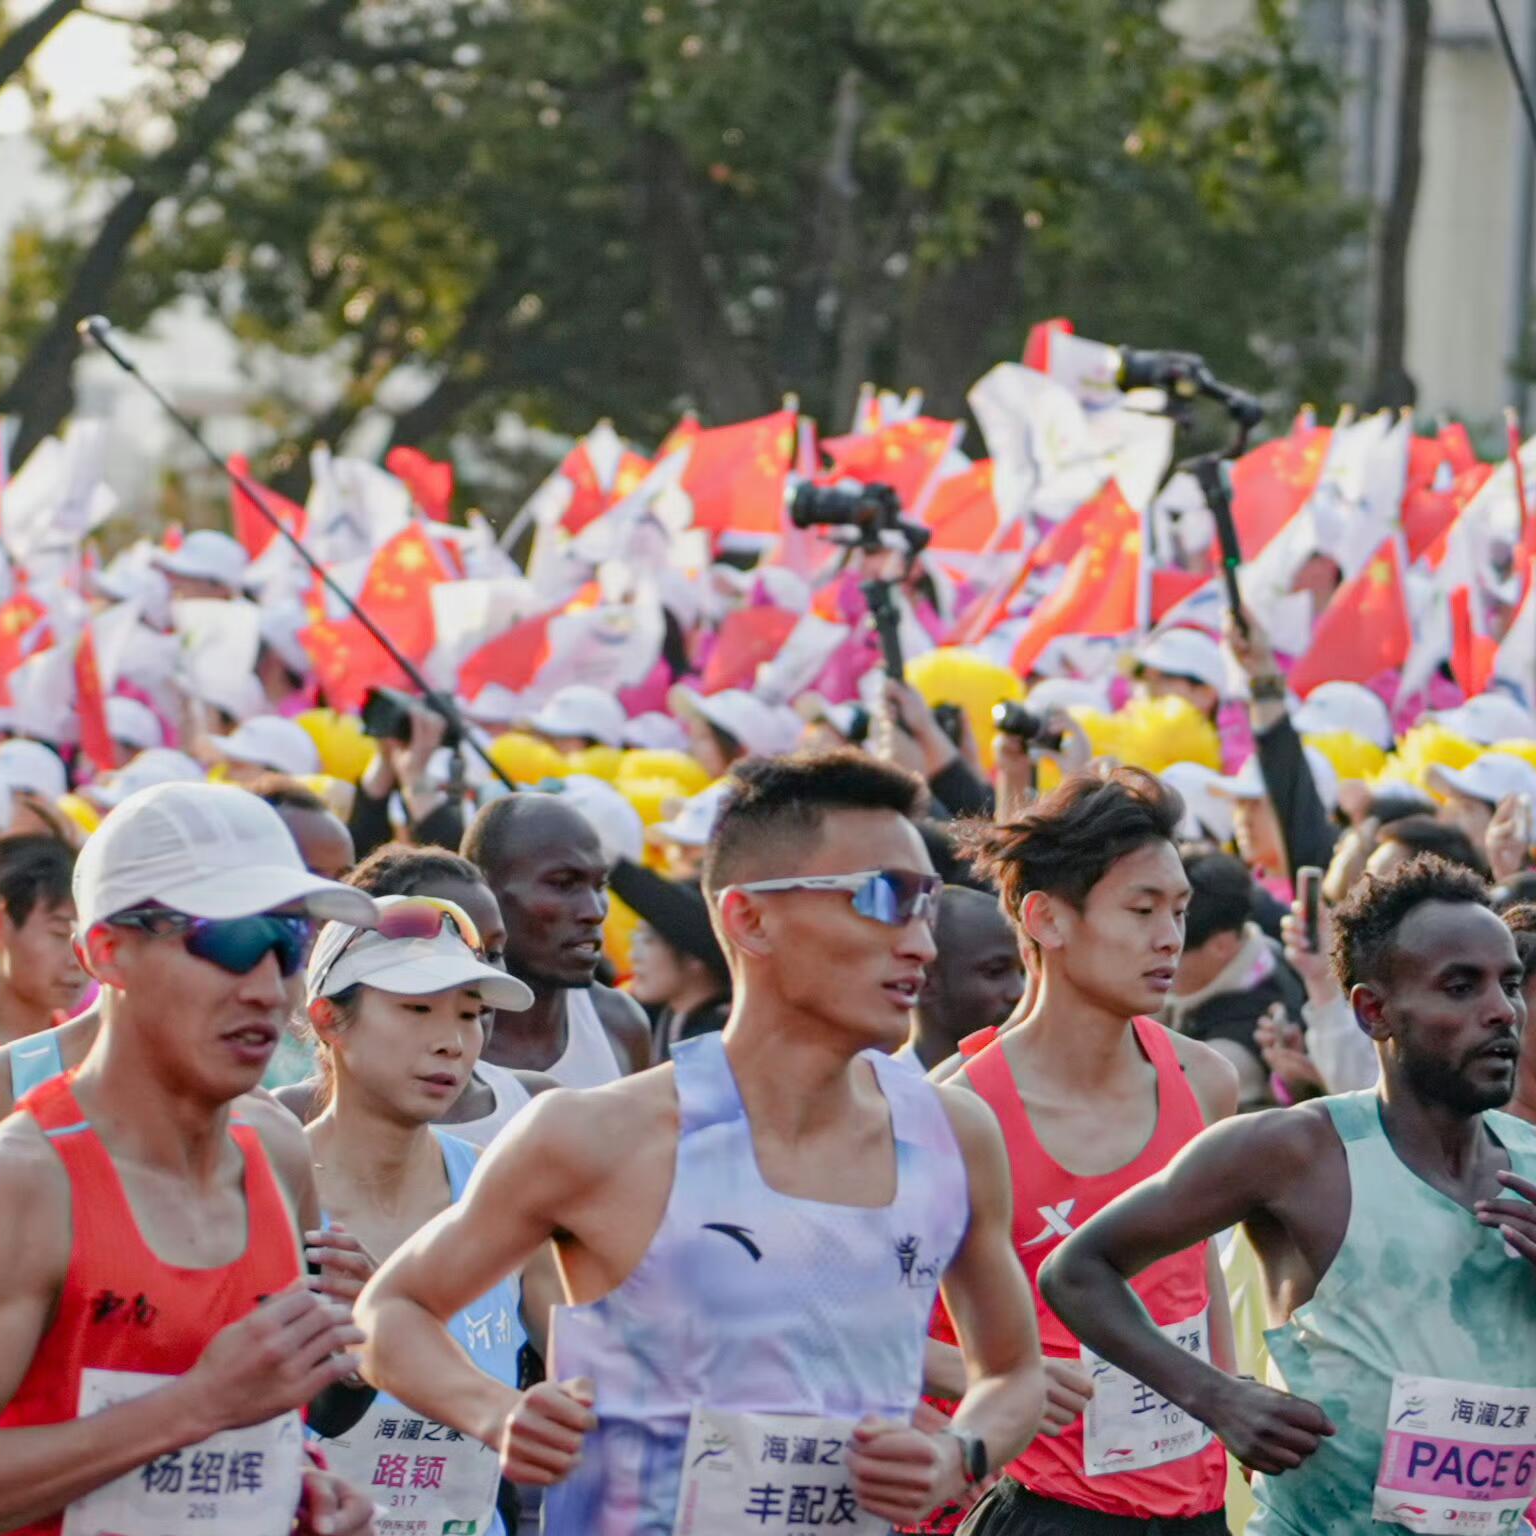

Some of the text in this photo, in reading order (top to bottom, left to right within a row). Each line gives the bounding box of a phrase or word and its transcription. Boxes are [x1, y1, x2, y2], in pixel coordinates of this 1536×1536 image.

[1451, 1398, 1530, 1428] 海澜之家
[140, 1451, 263, 1494] 杨绍辉
[372, 1454, 447, 1489] 路颖
[1407, 1440, 1513, 1487] PACE
[1515, 1450, 1536, 1486] 6
[390, 1495, 417, 1507] 317
[745, 1484, 857, 1525] 丰配友
